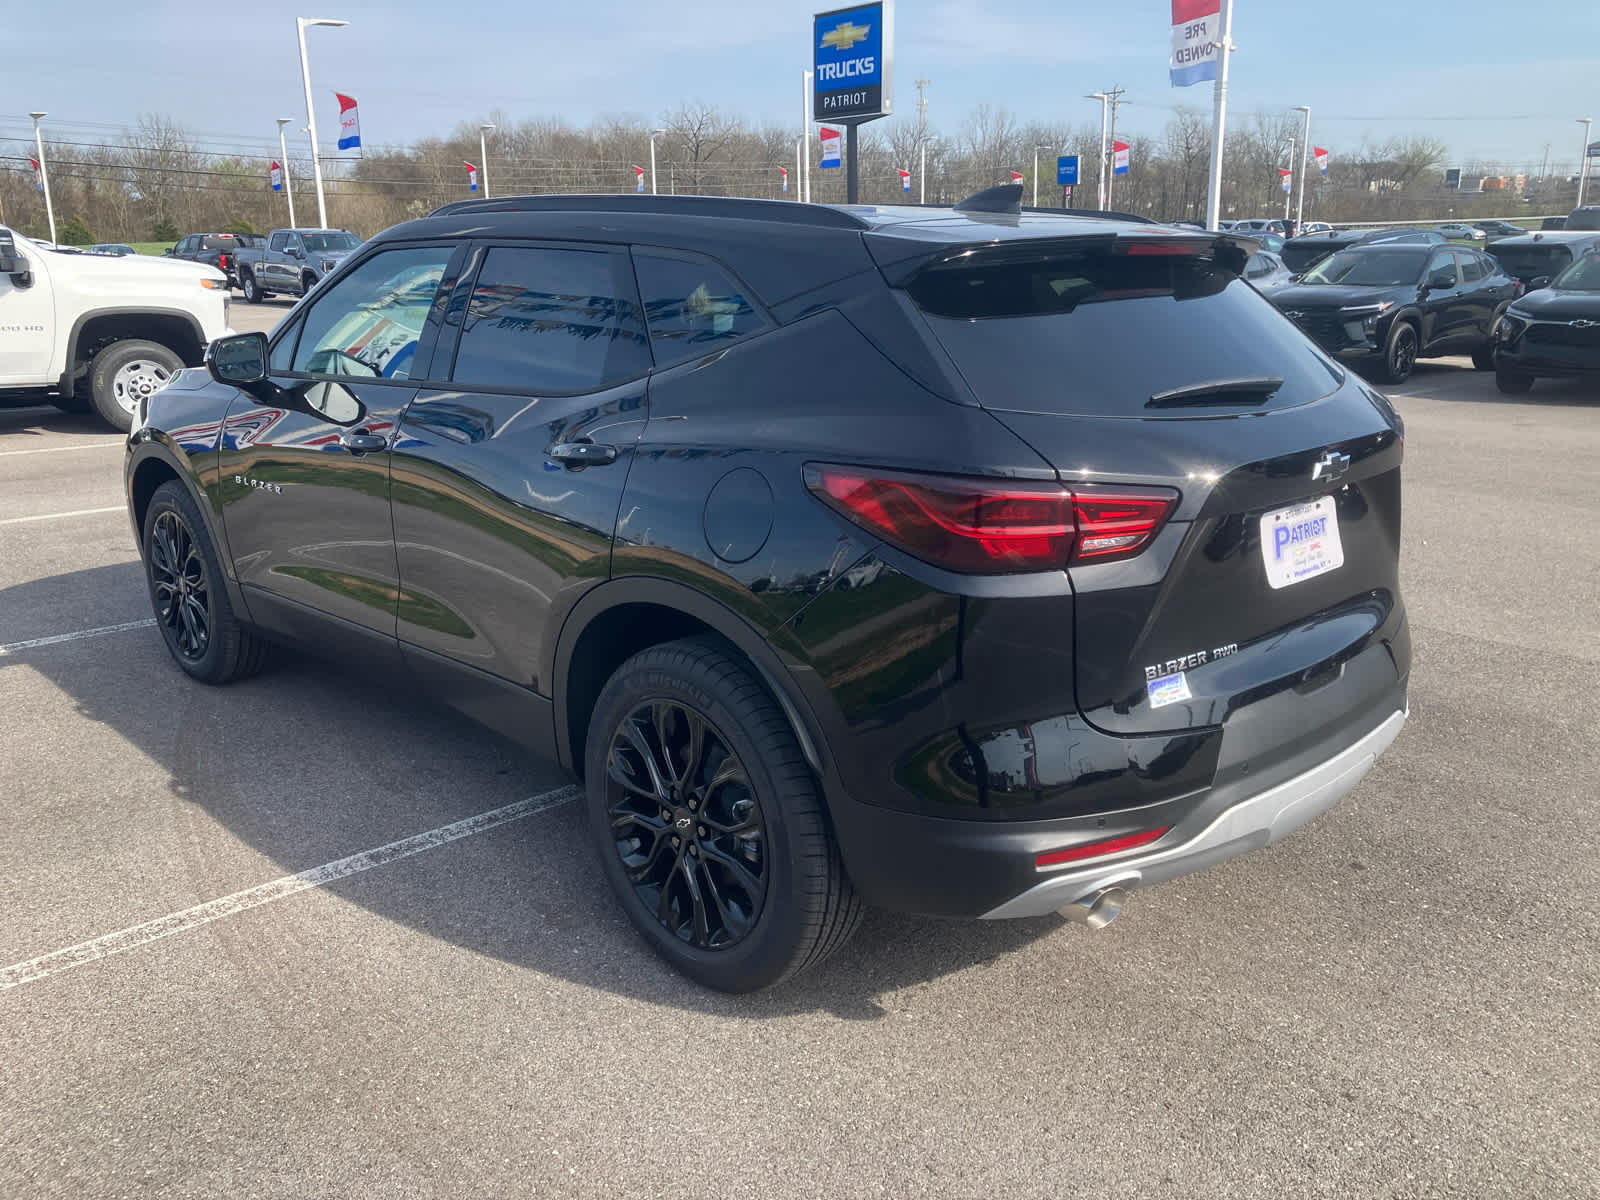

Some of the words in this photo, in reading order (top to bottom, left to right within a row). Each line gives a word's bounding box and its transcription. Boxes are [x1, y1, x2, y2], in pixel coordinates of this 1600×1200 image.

[817, 56, 875, 81] TRUCKS
[824, 92, 867, 108] PATRIOT
[235, 475, 282, 495] BLAZER
[1274, 517, 1326, 561] PATRIOT
[1145, 651, 1207, 680] BLAZER
[1213, 643, 1238, 659] AWD
